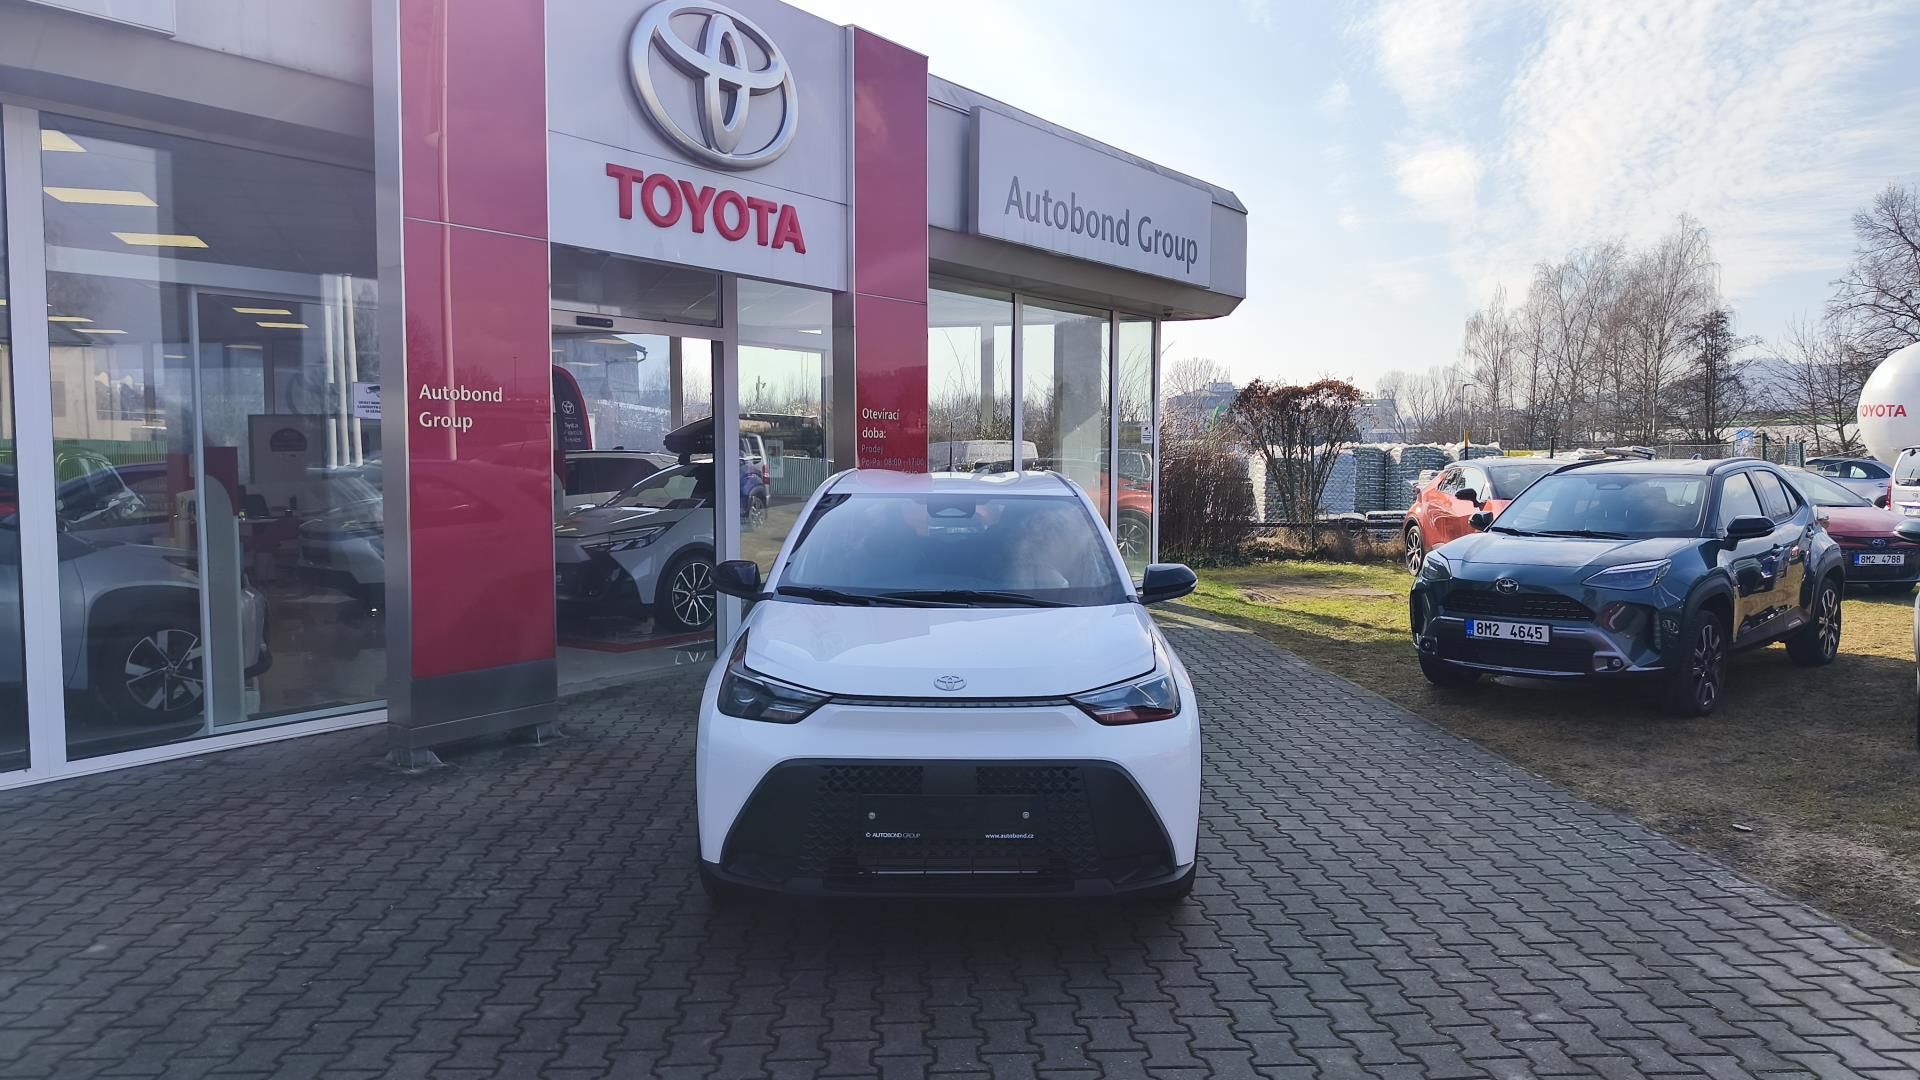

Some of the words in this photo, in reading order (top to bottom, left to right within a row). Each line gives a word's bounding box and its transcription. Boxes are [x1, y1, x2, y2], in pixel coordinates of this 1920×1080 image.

[606, 163, 806, 255] TOYOTA
[1004, 175, 1130, 247] Autobond
[1137, 216, 1198, 274] Group
[419, 383, 503, 402] Autobond
[419, 411, 473, 433] Group
[862, 427, 887, 439] doba:
[1861, 555, 1876, 564] 8M2
[1476, 622, 1500, 636] 8M2
[1510, 624, 1543, 640] 4645
